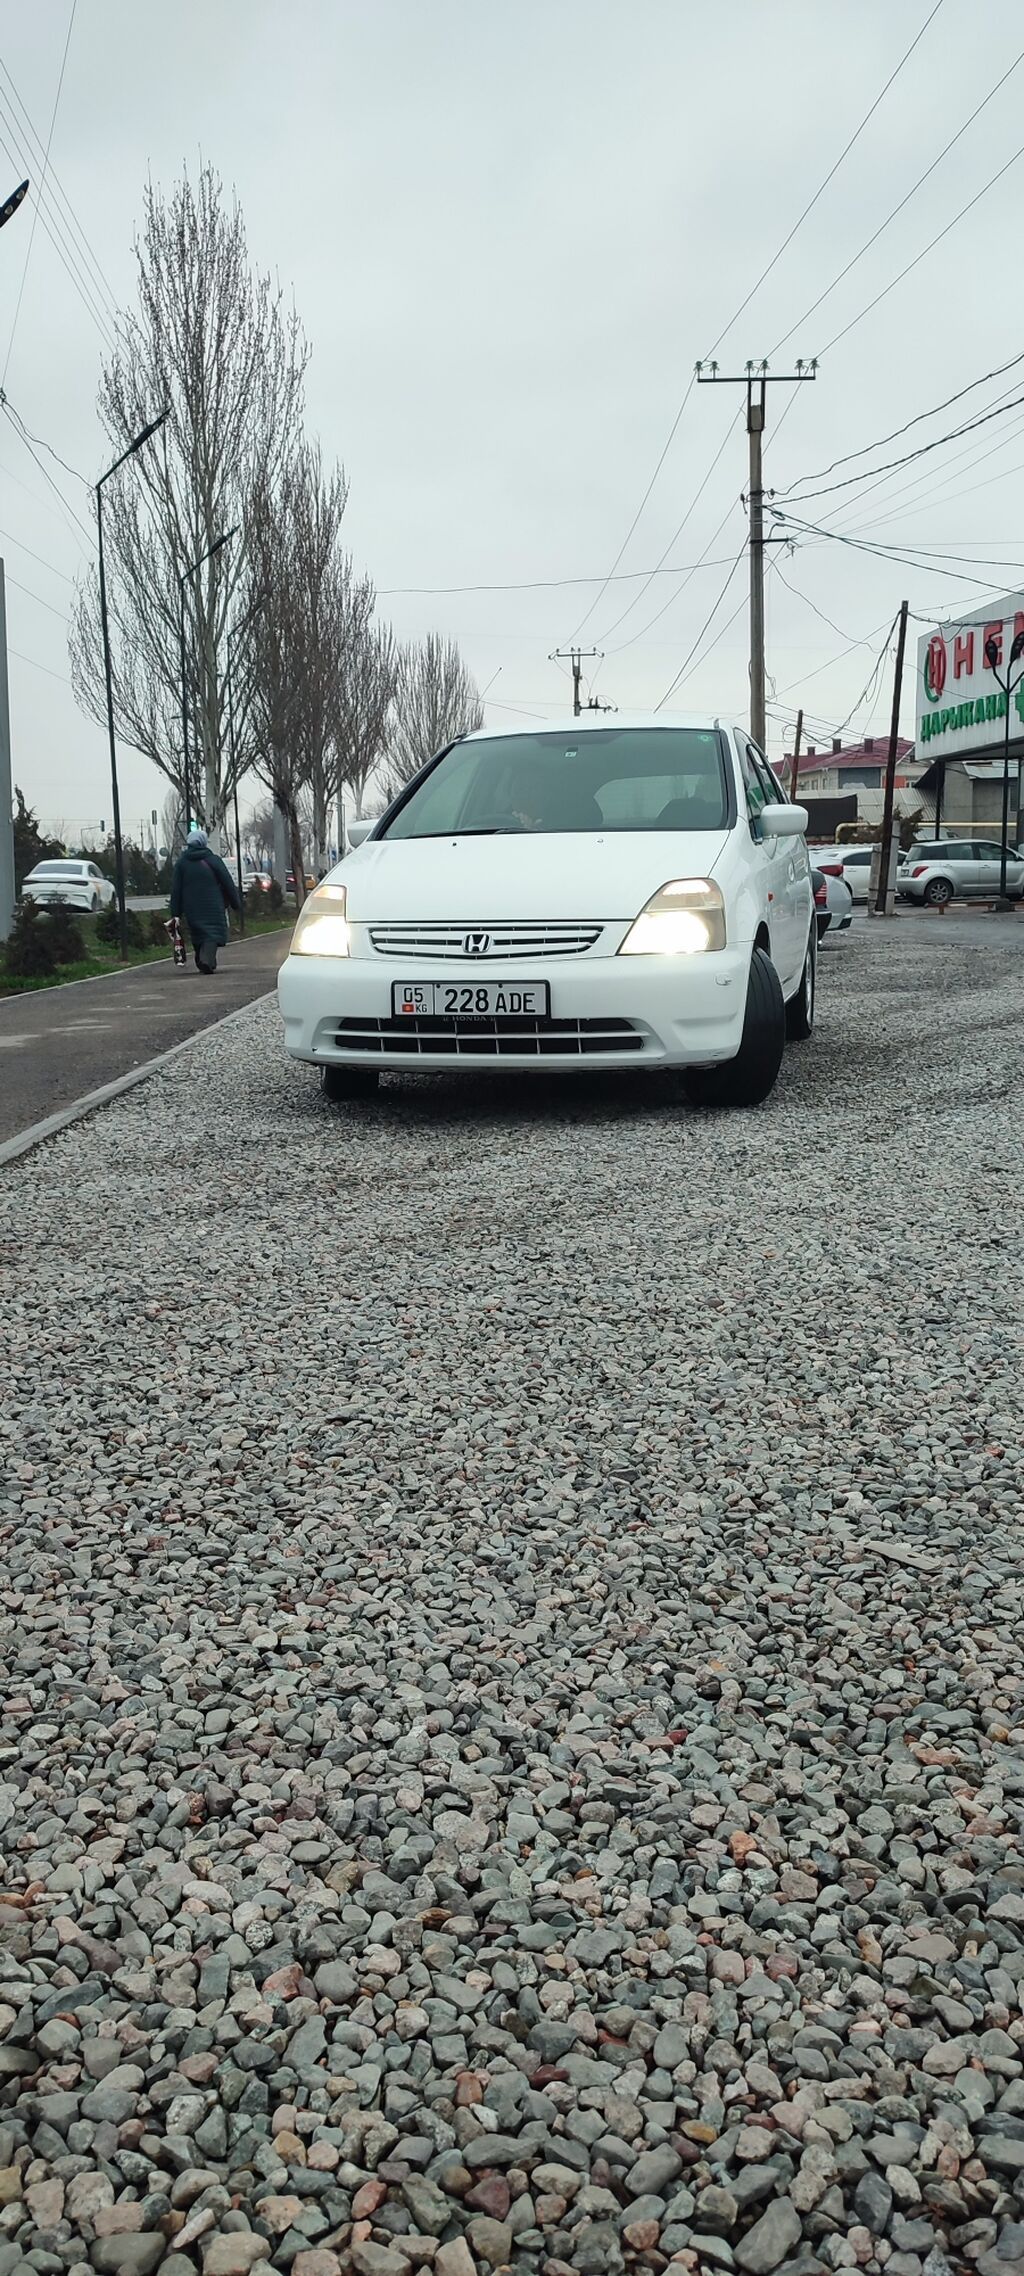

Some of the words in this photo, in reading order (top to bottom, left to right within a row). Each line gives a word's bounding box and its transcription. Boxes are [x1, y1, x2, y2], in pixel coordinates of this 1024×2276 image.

[920, 692, 1008, 743] ДАРЫКАНА
[403, 987, 424, 1003] 05
[444, 988, 489, 1013] 228
[495, 992, 536, 1013] ADE
[415, 1004, 428, 1013] KG
